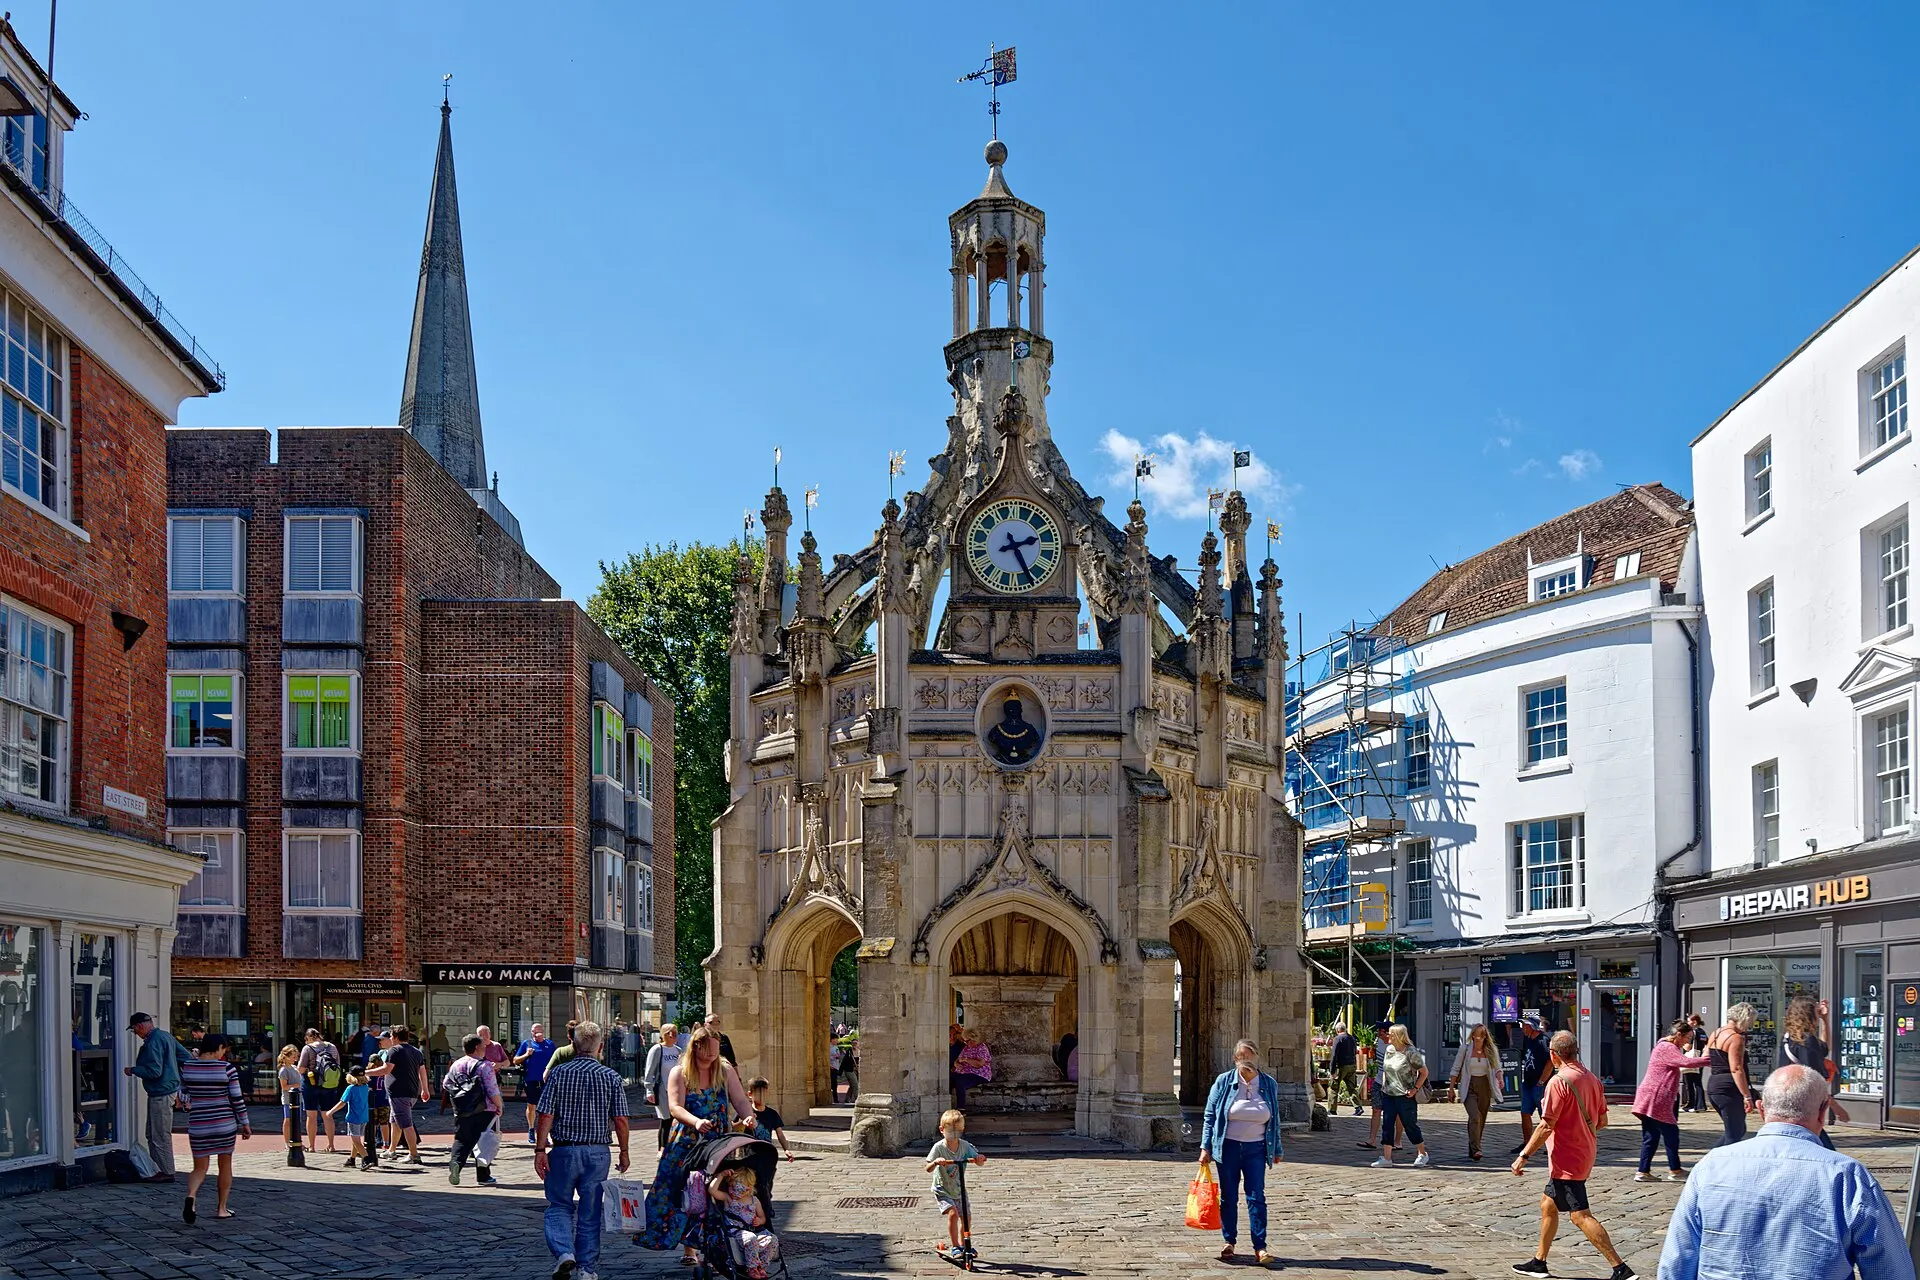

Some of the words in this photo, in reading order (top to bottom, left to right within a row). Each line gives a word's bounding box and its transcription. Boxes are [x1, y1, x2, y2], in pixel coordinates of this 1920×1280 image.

[106, 791, 122, 805] EAST
[123, 796, 145, 812] STREET
[1730, 885, 1809, 917] REPAIR
[1815, 875, 1870, 905] HUB
[438, 969, 493, 981] FRANCO
[499, 969, 552, 981] MANCA
[1791, 963, 1820, 971] Chargers
